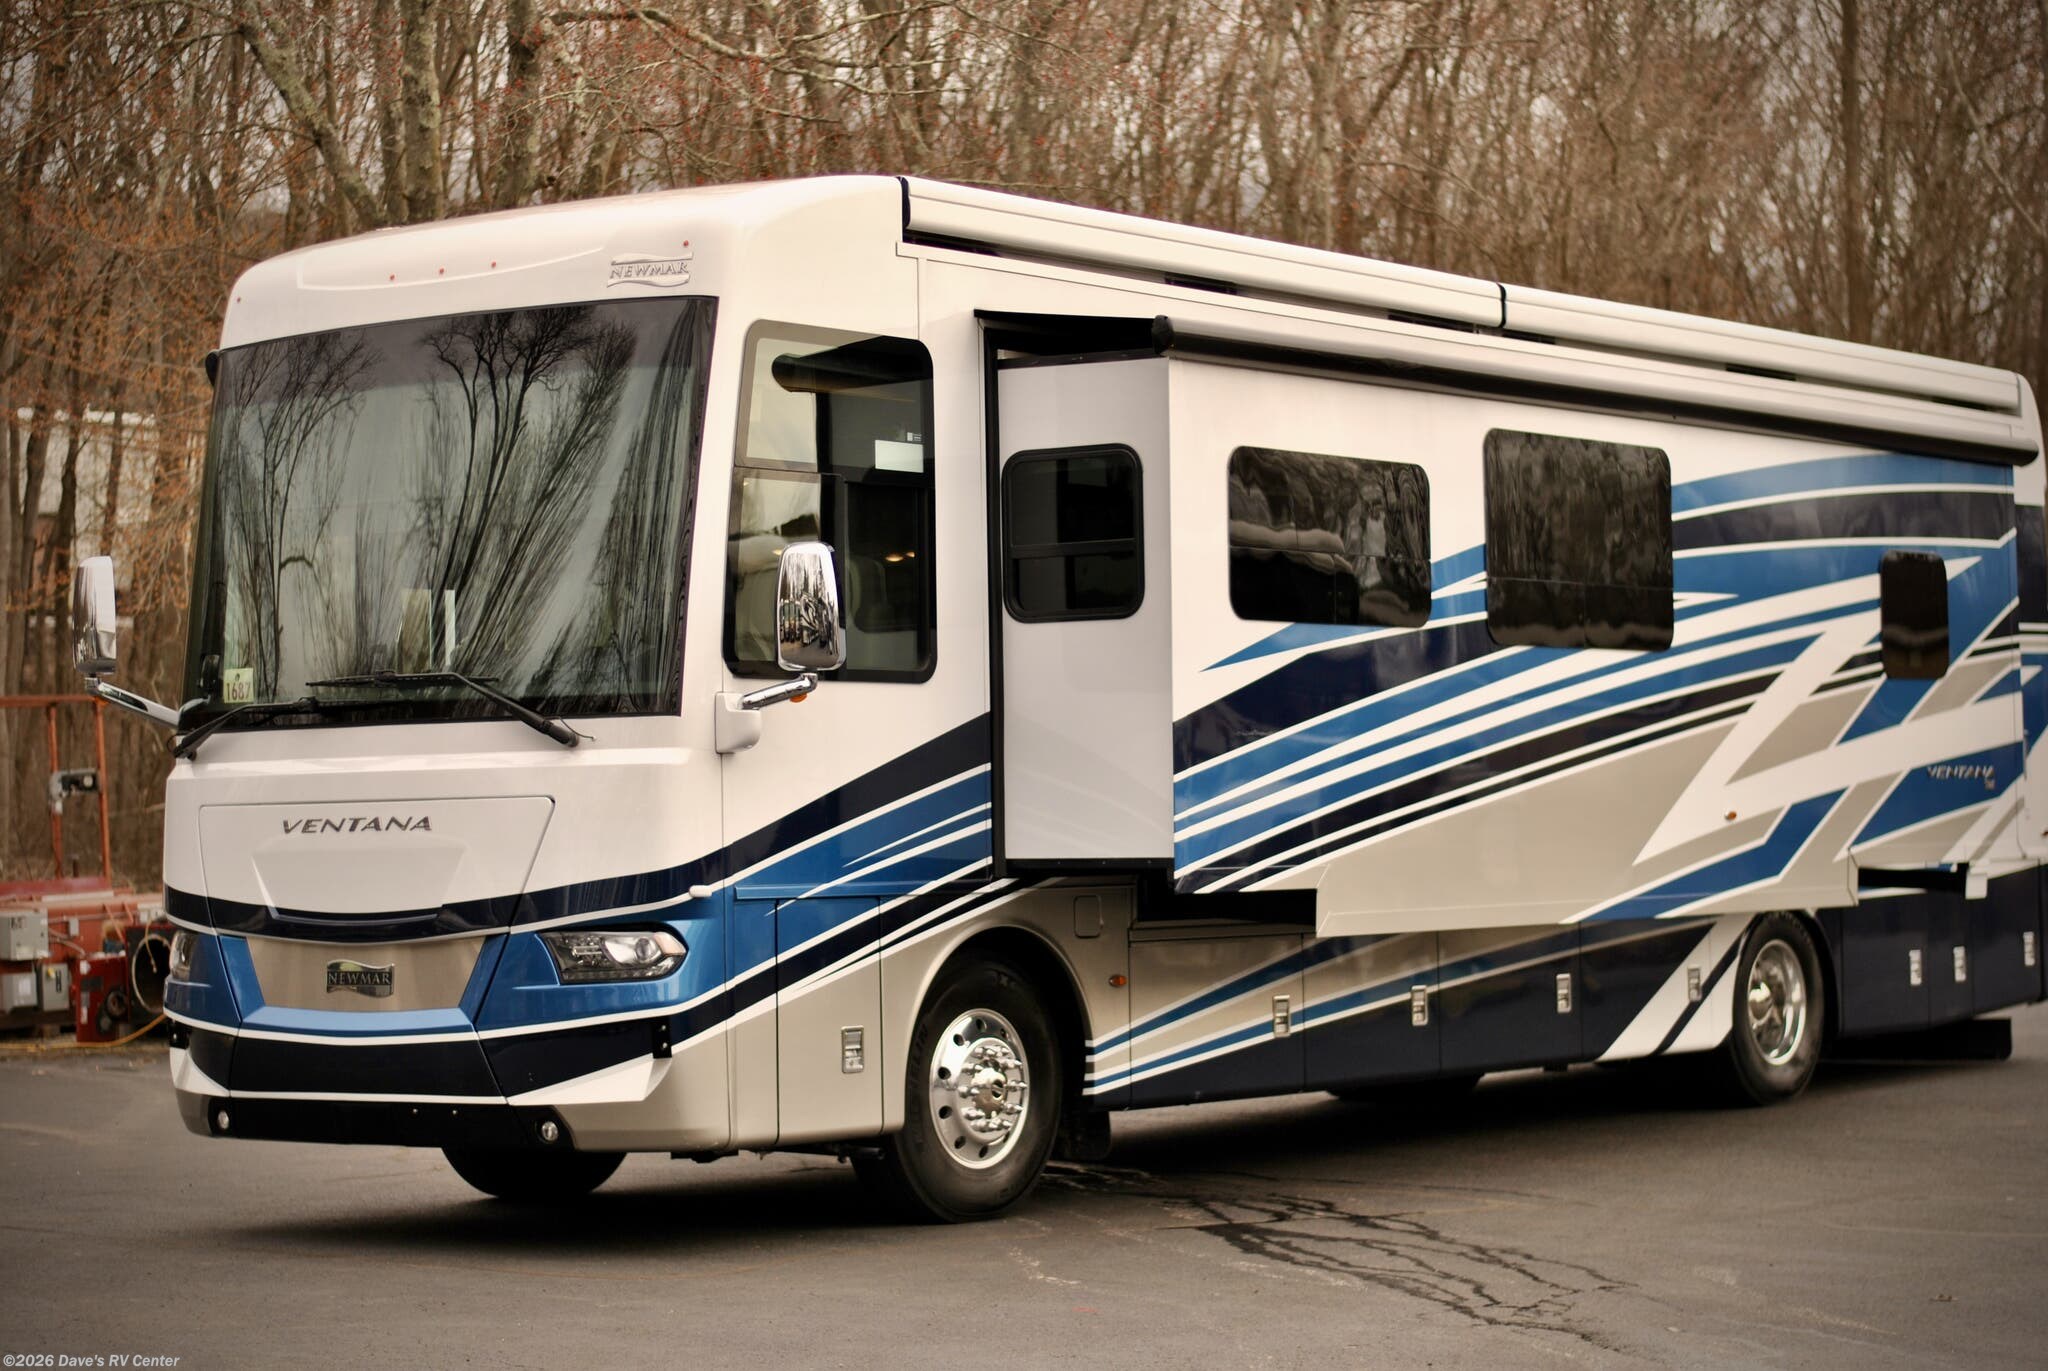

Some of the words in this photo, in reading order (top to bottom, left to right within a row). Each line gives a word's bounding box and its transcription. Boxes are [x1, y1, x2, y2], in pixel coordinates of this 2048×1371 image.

[609, 262, 689, 279] NEWMAR
[226, 682, 251, 701] 1687
[1926, 765, 1996, 779] VENTANA
[282, 815, 432, 834] VENTANA
[328, 971, 391, 985] NEWMAR
